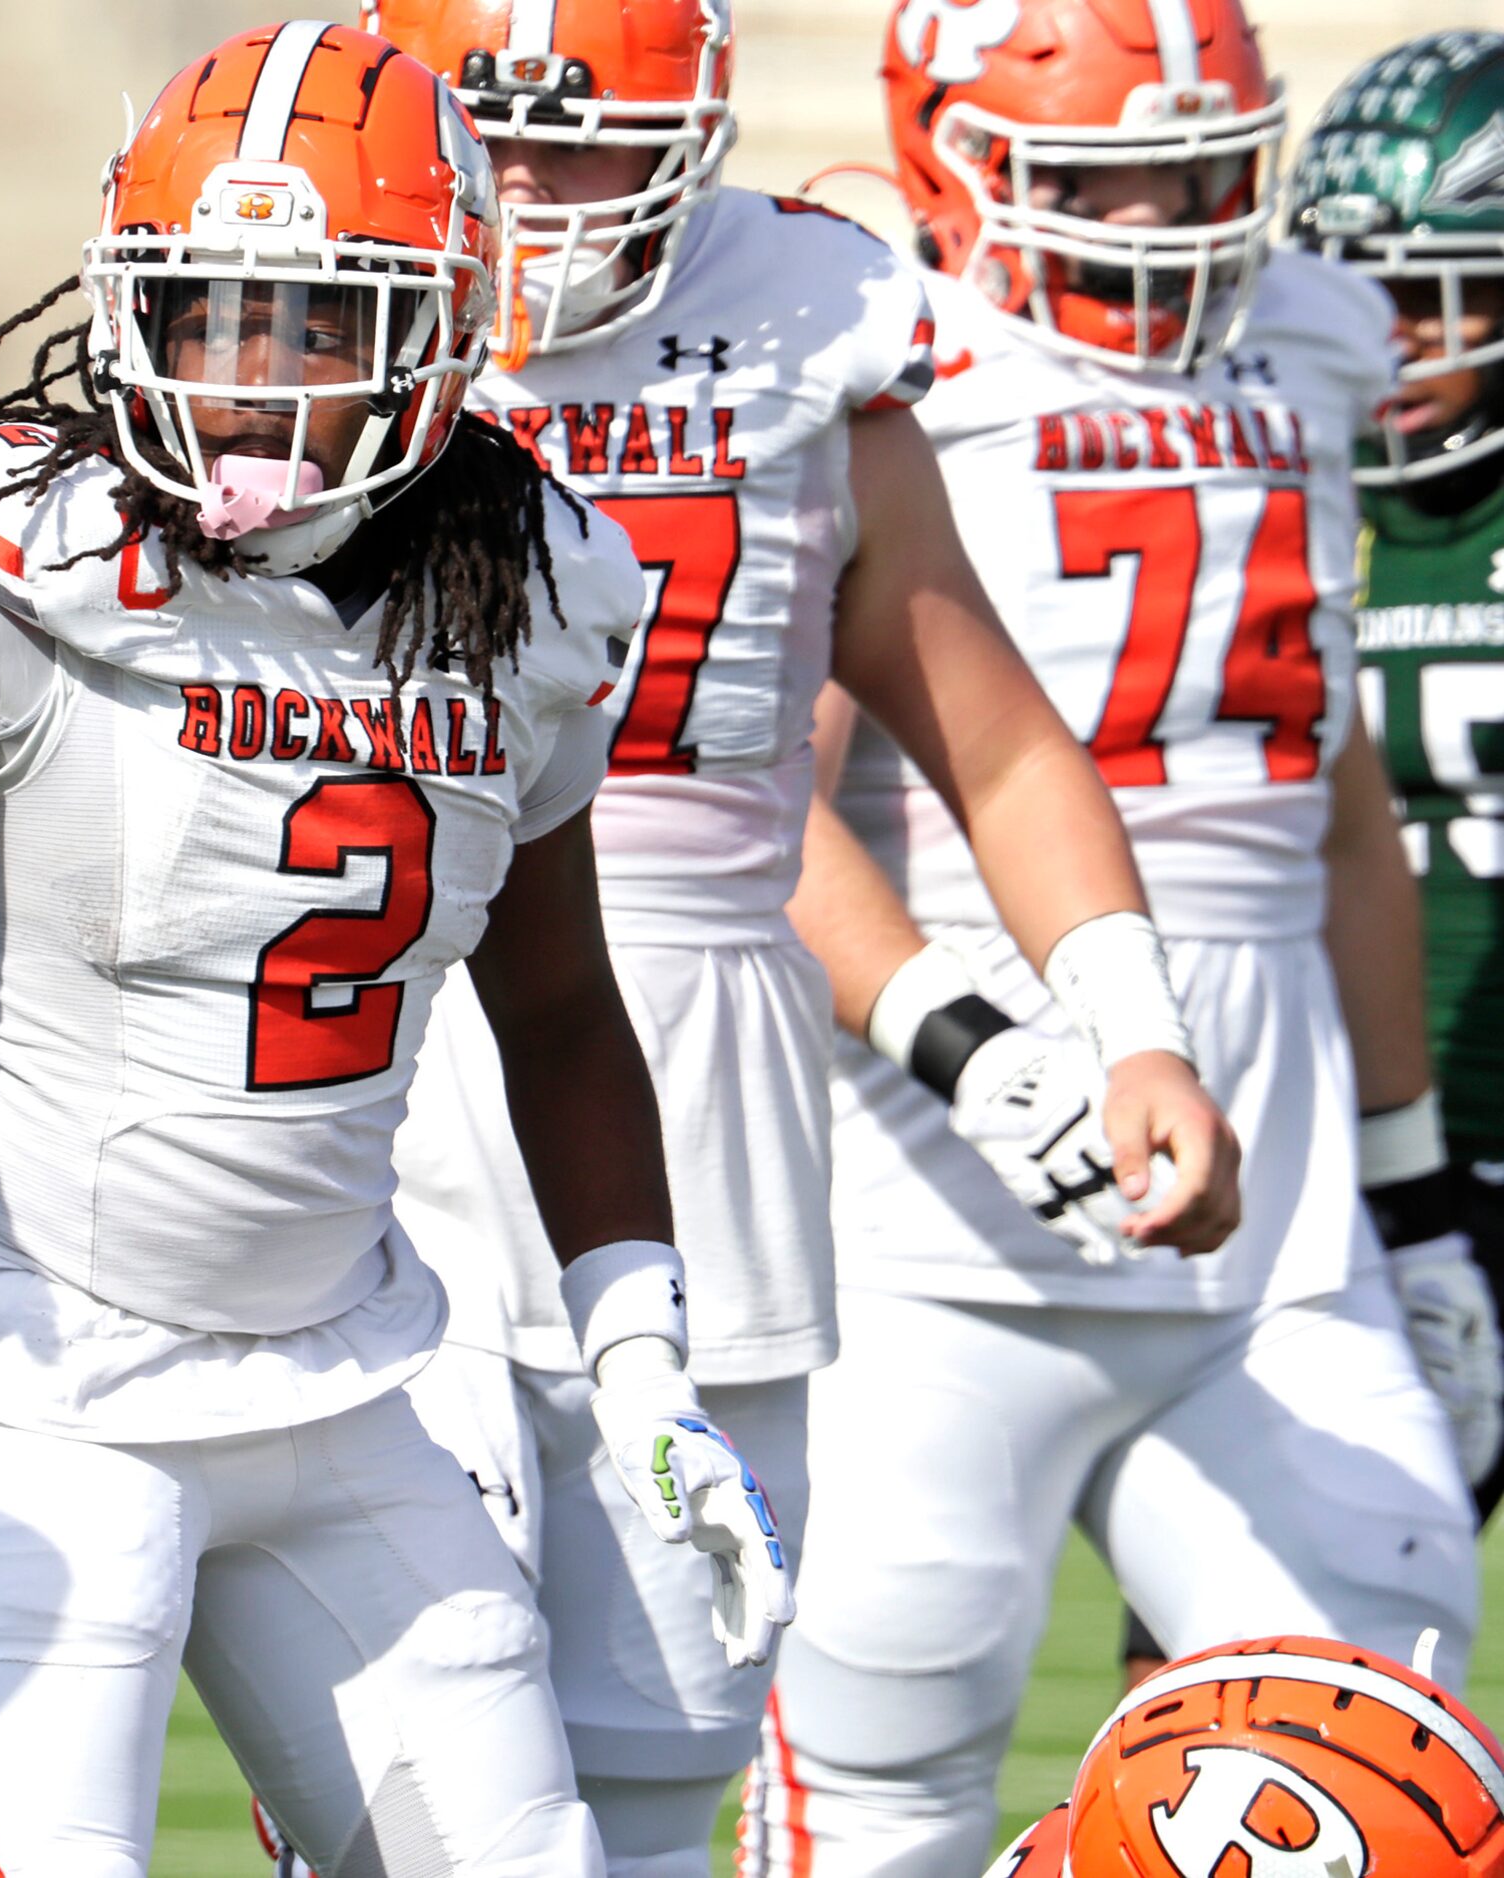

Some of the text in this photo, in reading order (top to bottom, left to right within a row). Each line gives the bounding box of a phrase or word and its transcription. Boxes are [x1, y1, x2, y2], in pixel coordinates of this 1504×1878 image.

[177, 682, 507, 777] ROCKWALL
[1050, 484, 1327, 787] 74
[244, 772, 438, 1092] 2
